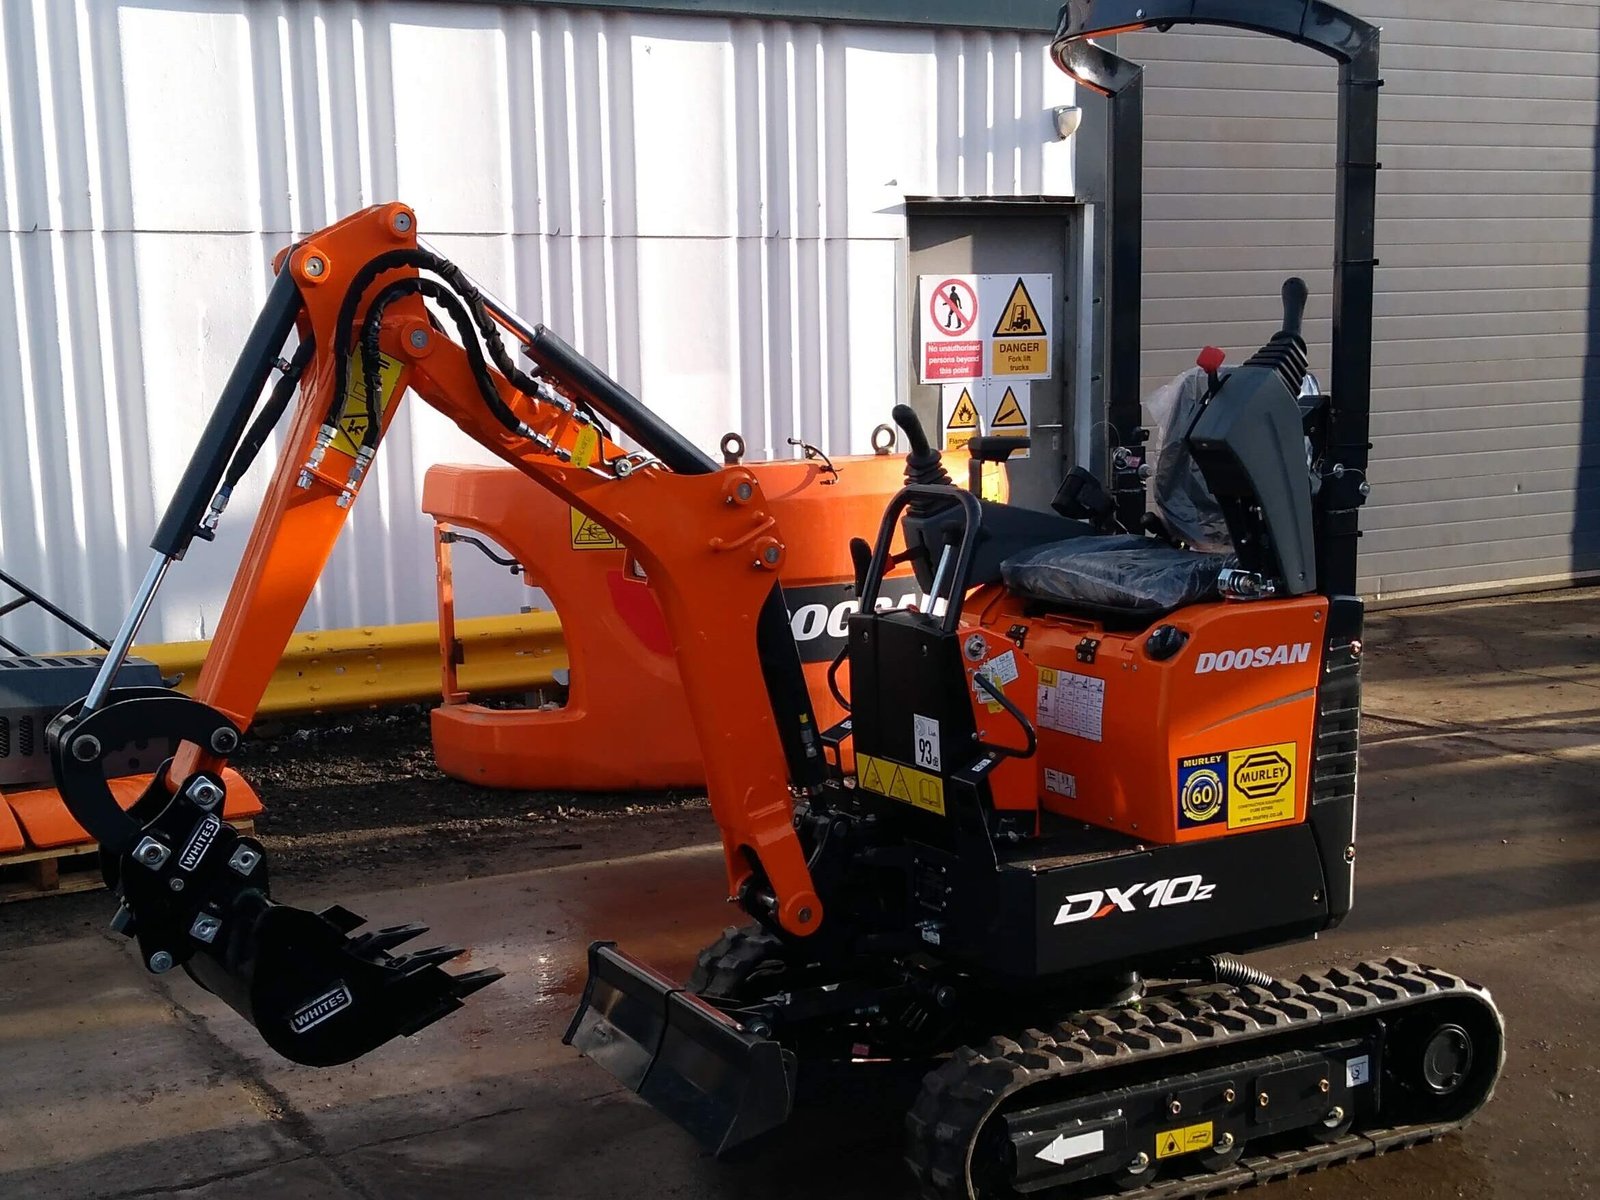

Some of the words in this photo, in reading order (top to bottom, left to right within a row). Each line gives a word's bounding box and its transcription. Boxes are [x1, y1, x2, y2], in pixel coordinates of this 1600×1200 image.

[1000, 342, 1040, 353] DANGER
[928, 357, 955, 366] persons
[956, 355, 980, 364] beyond
[953, 367, 969, 375] point
[1195, 643, 1311, 674] DOOSAN
[919, 738, 932, 765] 93
[1183, 755, 1222, 768] MURLEY
[1239, 766, 1286, 784] MURLEY
[1192, 785, 1213, 805] 60
[184, 822, 215, 865] WHITES
[295, 992, 345, 1026] WHITES
